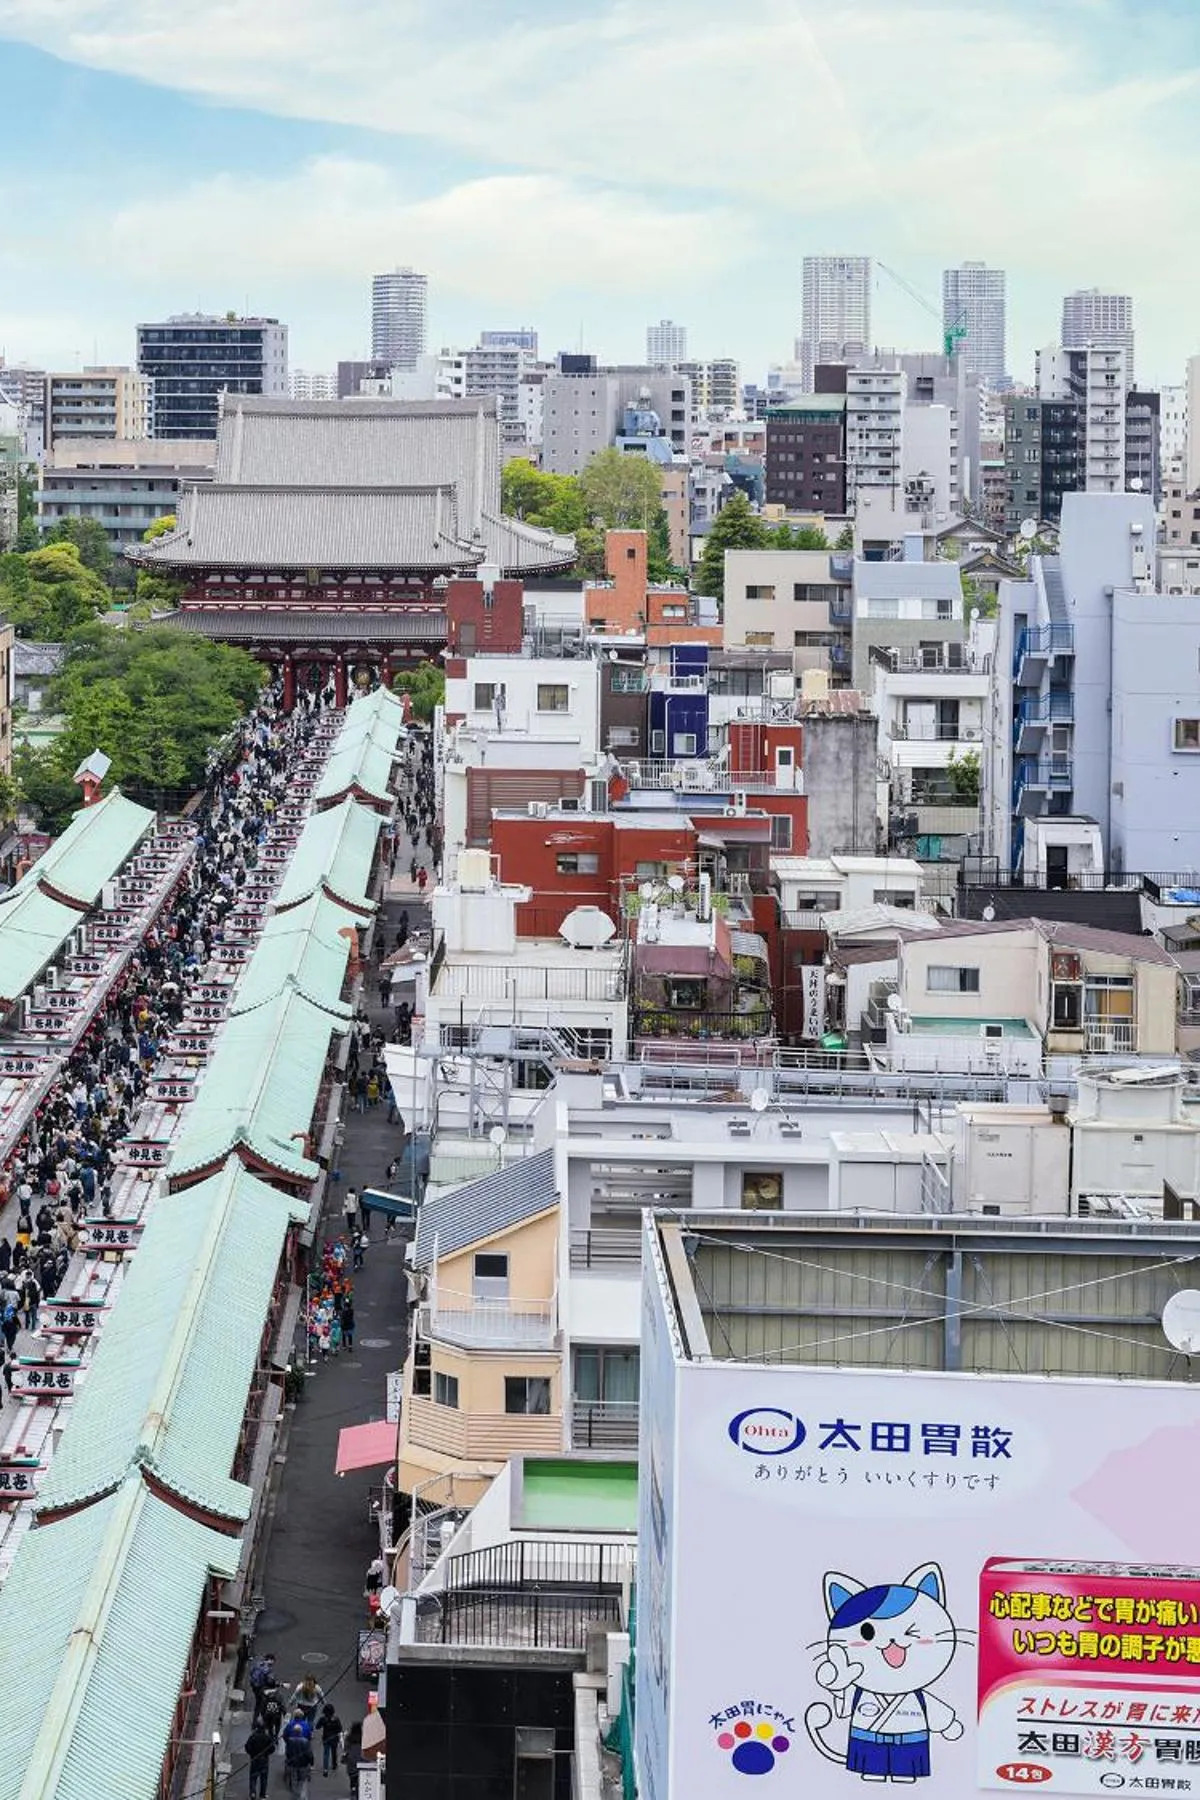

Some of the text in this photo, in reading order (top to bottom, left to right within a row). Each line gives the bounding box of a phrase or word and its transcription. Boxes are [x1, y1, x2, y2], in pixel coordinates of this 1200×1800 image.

[744, 1424, 791, 1439] Ohta
[818, 1418, 1014, 1459] 太田胃散
[753, 1464, 1002, 1491] ありがとう いいくすりです
[989, 1591, 1198, 1627] 心配事などで胃が痛い
[1012, 1629, 1200, 1664] いつも胃の調子が悪
[709, 1700, 796, 1733] 太田胃にゃん
[1004, 1767, 1044, 1780] 14包
[1128, 1776, 1192, 1791] 太田胃散
